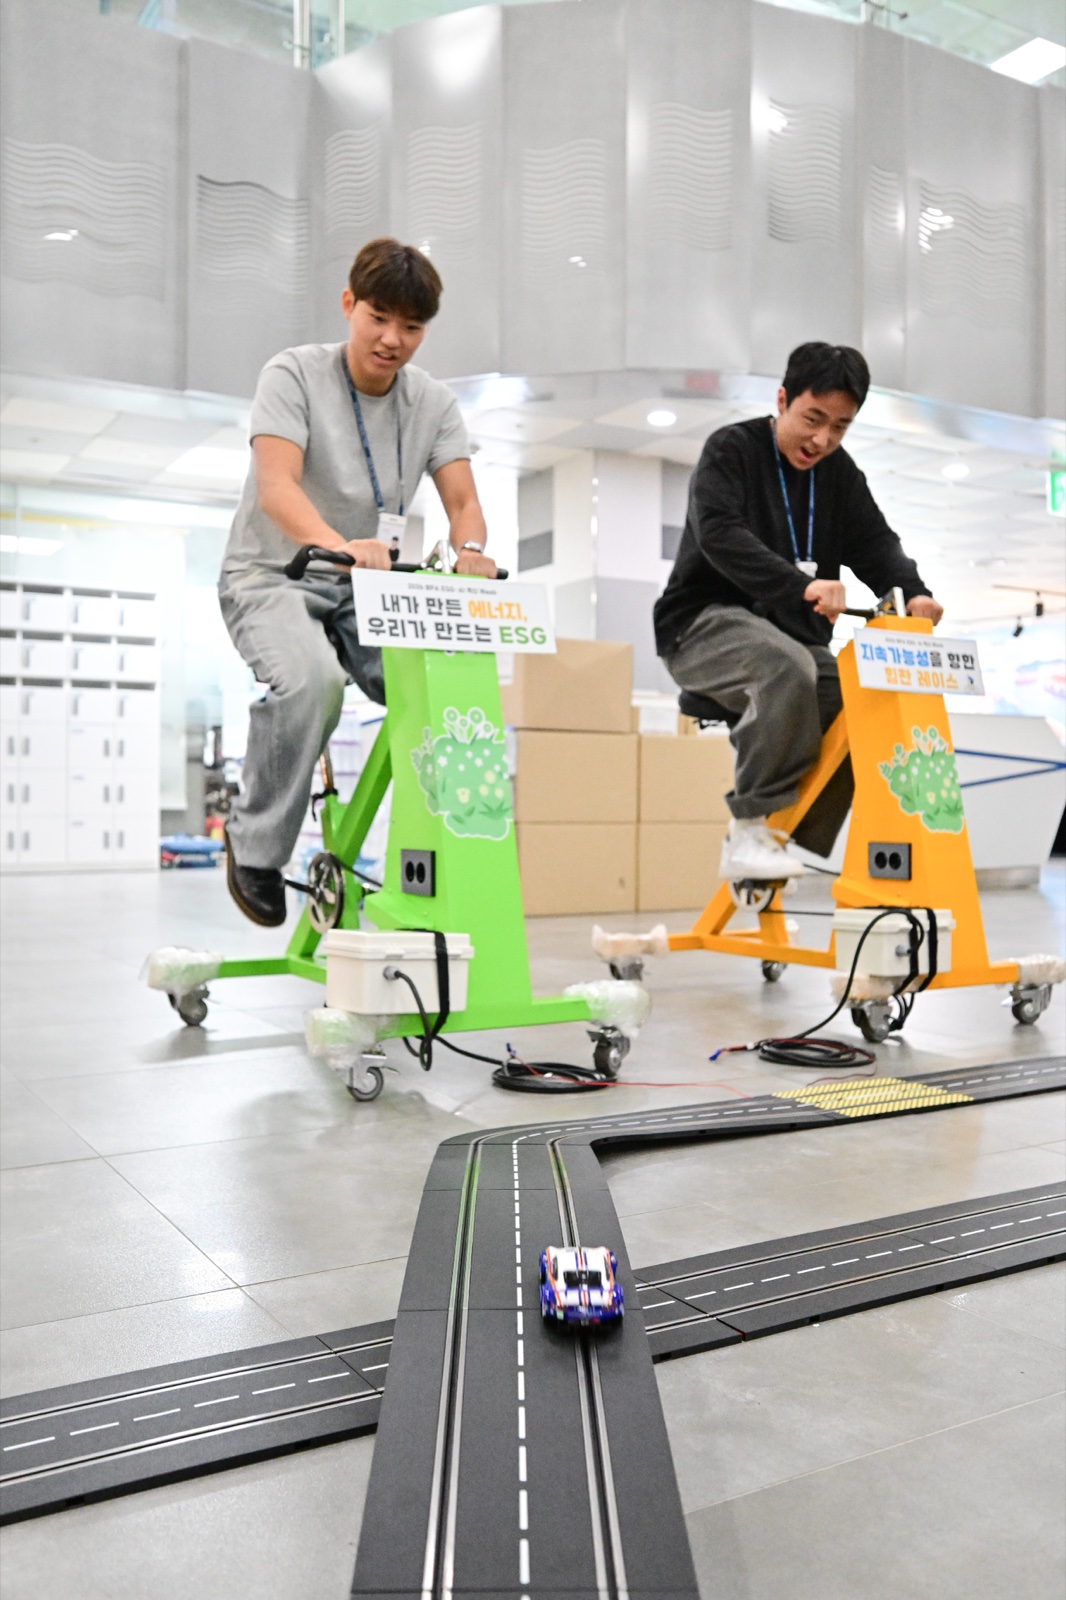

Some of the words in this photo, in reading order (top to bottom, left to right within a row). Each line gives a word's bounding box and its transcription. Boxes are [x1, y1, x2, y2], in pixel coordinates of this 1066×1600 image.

[381, 593, 420, 615] 내가
[425, 597, 463, 618] 만든
[468, 600, 528, 622] 에너지,
[368, 616, 427, 640] 우리가
[434, 622, 492, 643] 만드는
[498, 626, 547, 645] ESG
[860, 643, 943, 668] 지속가능성을
[947, 651, 976, 671] 향한
[885, 666, 912, 686] 힘찬
[917, 669, 959, 690] 레이스
